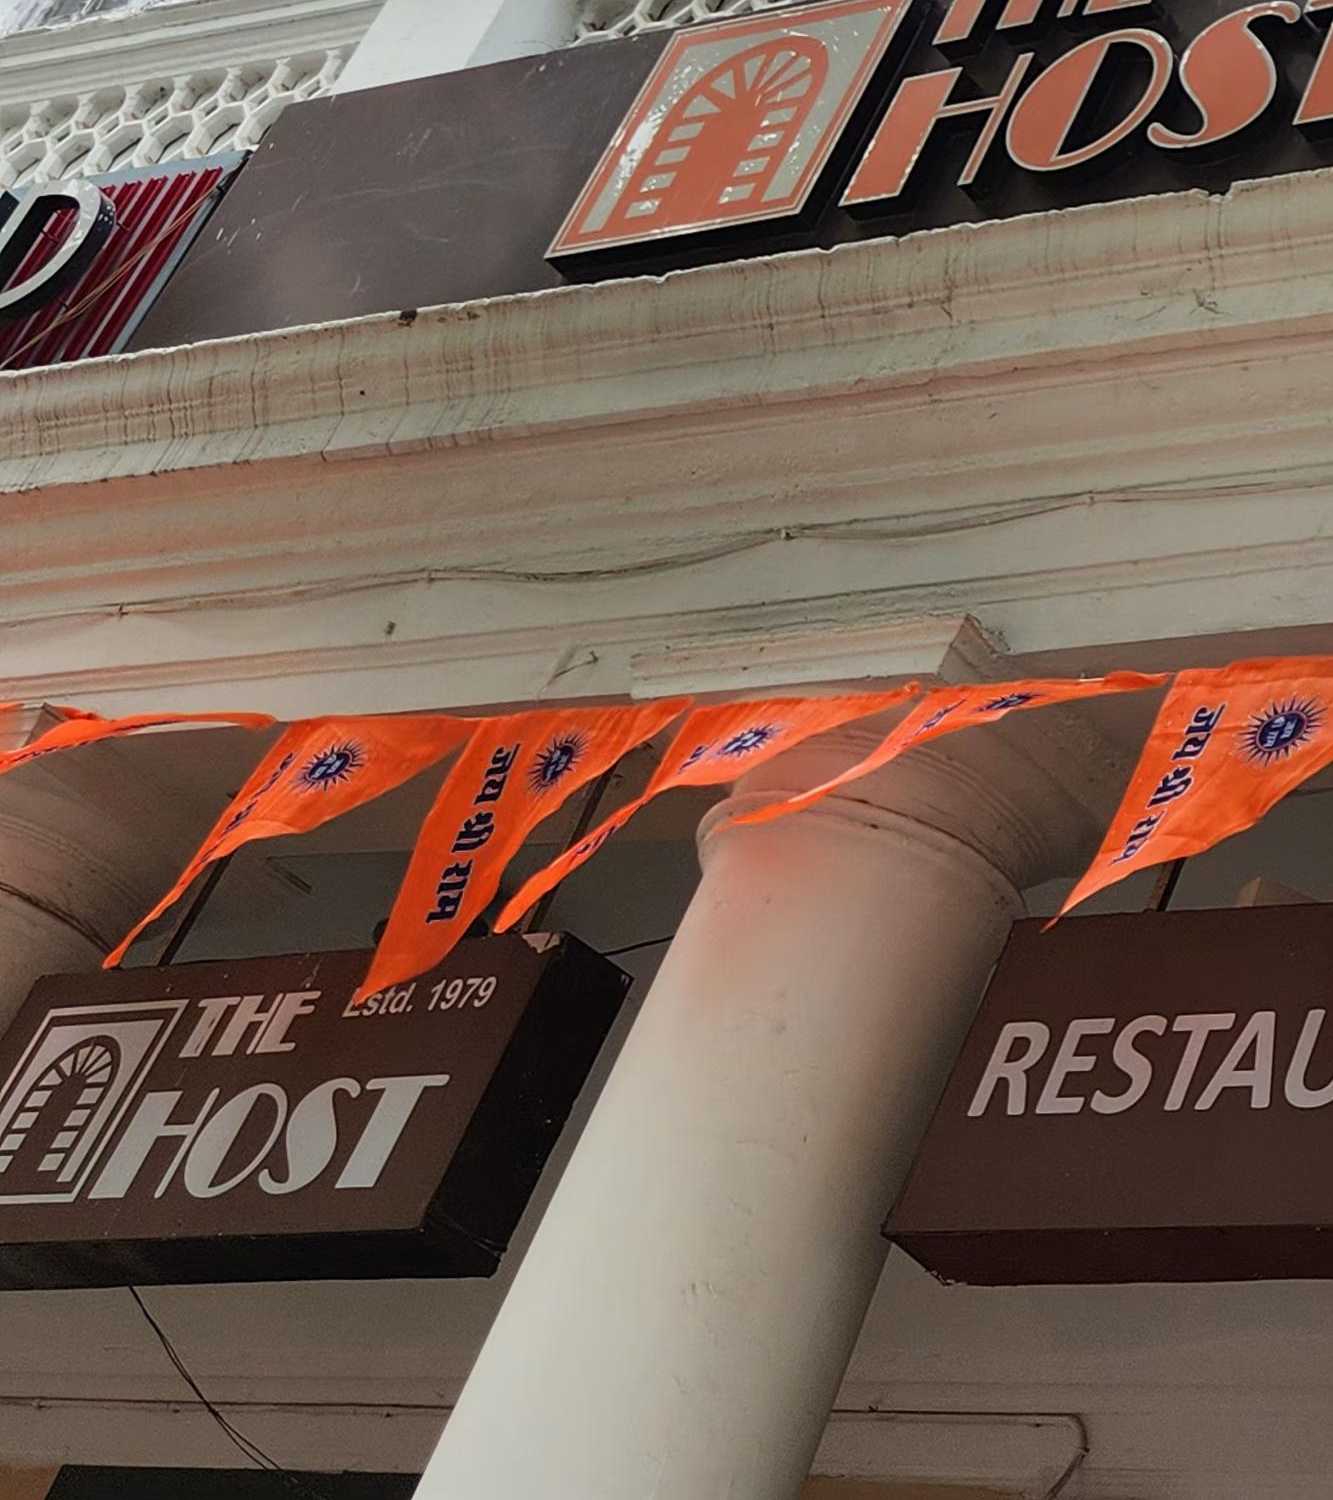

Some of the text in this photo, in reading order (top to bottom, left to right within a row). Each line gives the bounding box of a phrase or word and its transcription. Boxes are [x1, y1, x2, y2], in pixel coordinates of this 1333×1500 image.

[1170, 701, 1228, 762] जय
[1146, 765, 1195, 811] श्री
[425, 741, 521, 925] जय श्री राम
[179, 990, 321, 1058] THE
[427, 976, 497, 1011] 1979
[87, 1074, 450, 1200] HOST
